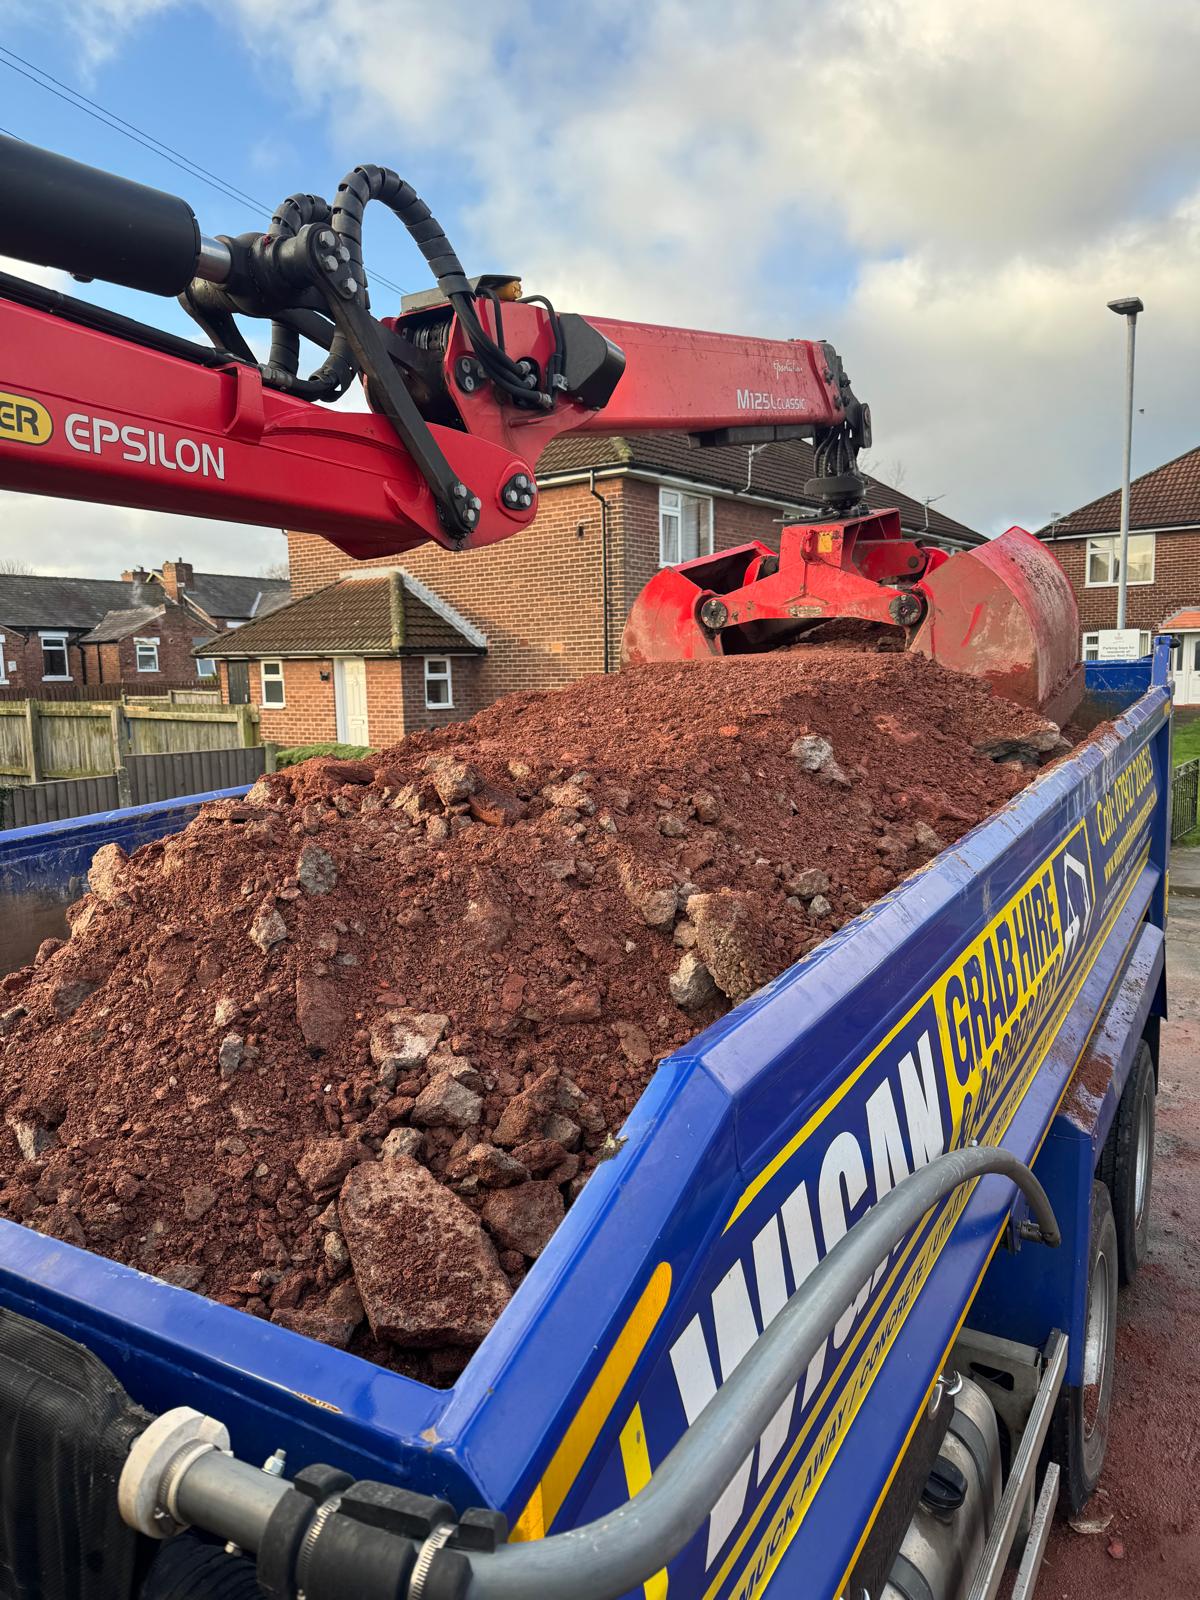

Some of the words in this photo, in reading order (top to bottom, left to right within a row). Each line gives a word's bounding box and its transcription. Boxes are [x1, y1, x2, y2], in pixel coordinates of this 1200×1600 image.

[64, 413, 225, 480] EPSILON
[1097, 792, 1117, 846] Call:
[738, 1489, 799, 1600] MUCK
[799, 1398, 850, 1504] AWAY
[859, 1254, 925, 1391] CONCRETE
